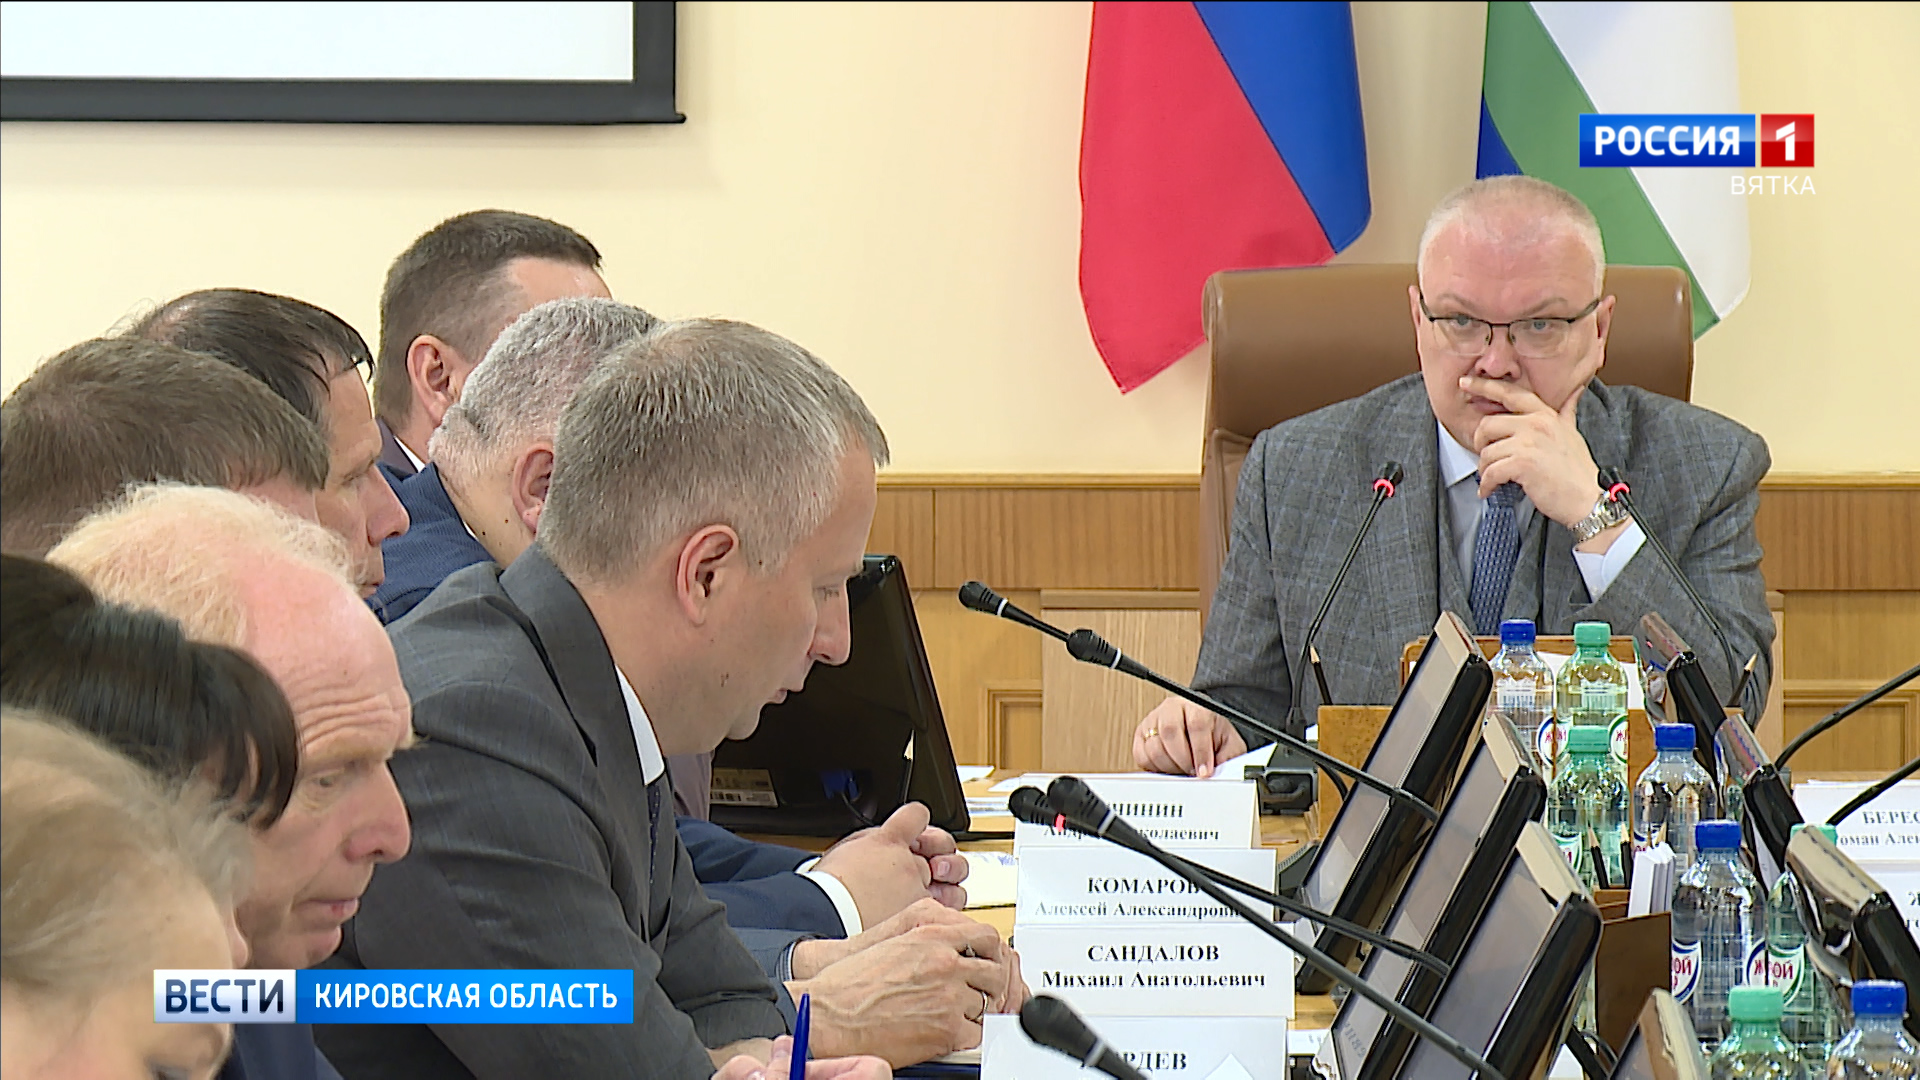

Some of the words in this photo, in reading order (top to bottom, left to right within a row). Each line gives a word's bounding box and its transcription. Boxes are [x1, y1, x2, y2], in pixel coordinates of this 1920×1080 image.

[1840, 835, 1879, 846] оман
[1034, 901, 1107, 916] Алексей
[1087, 945, 1219, 964] САНДАЛОВ
[1042, 971, 1123, 987] Михаил
[1131, 971, 1265, 987] Анатольевич
